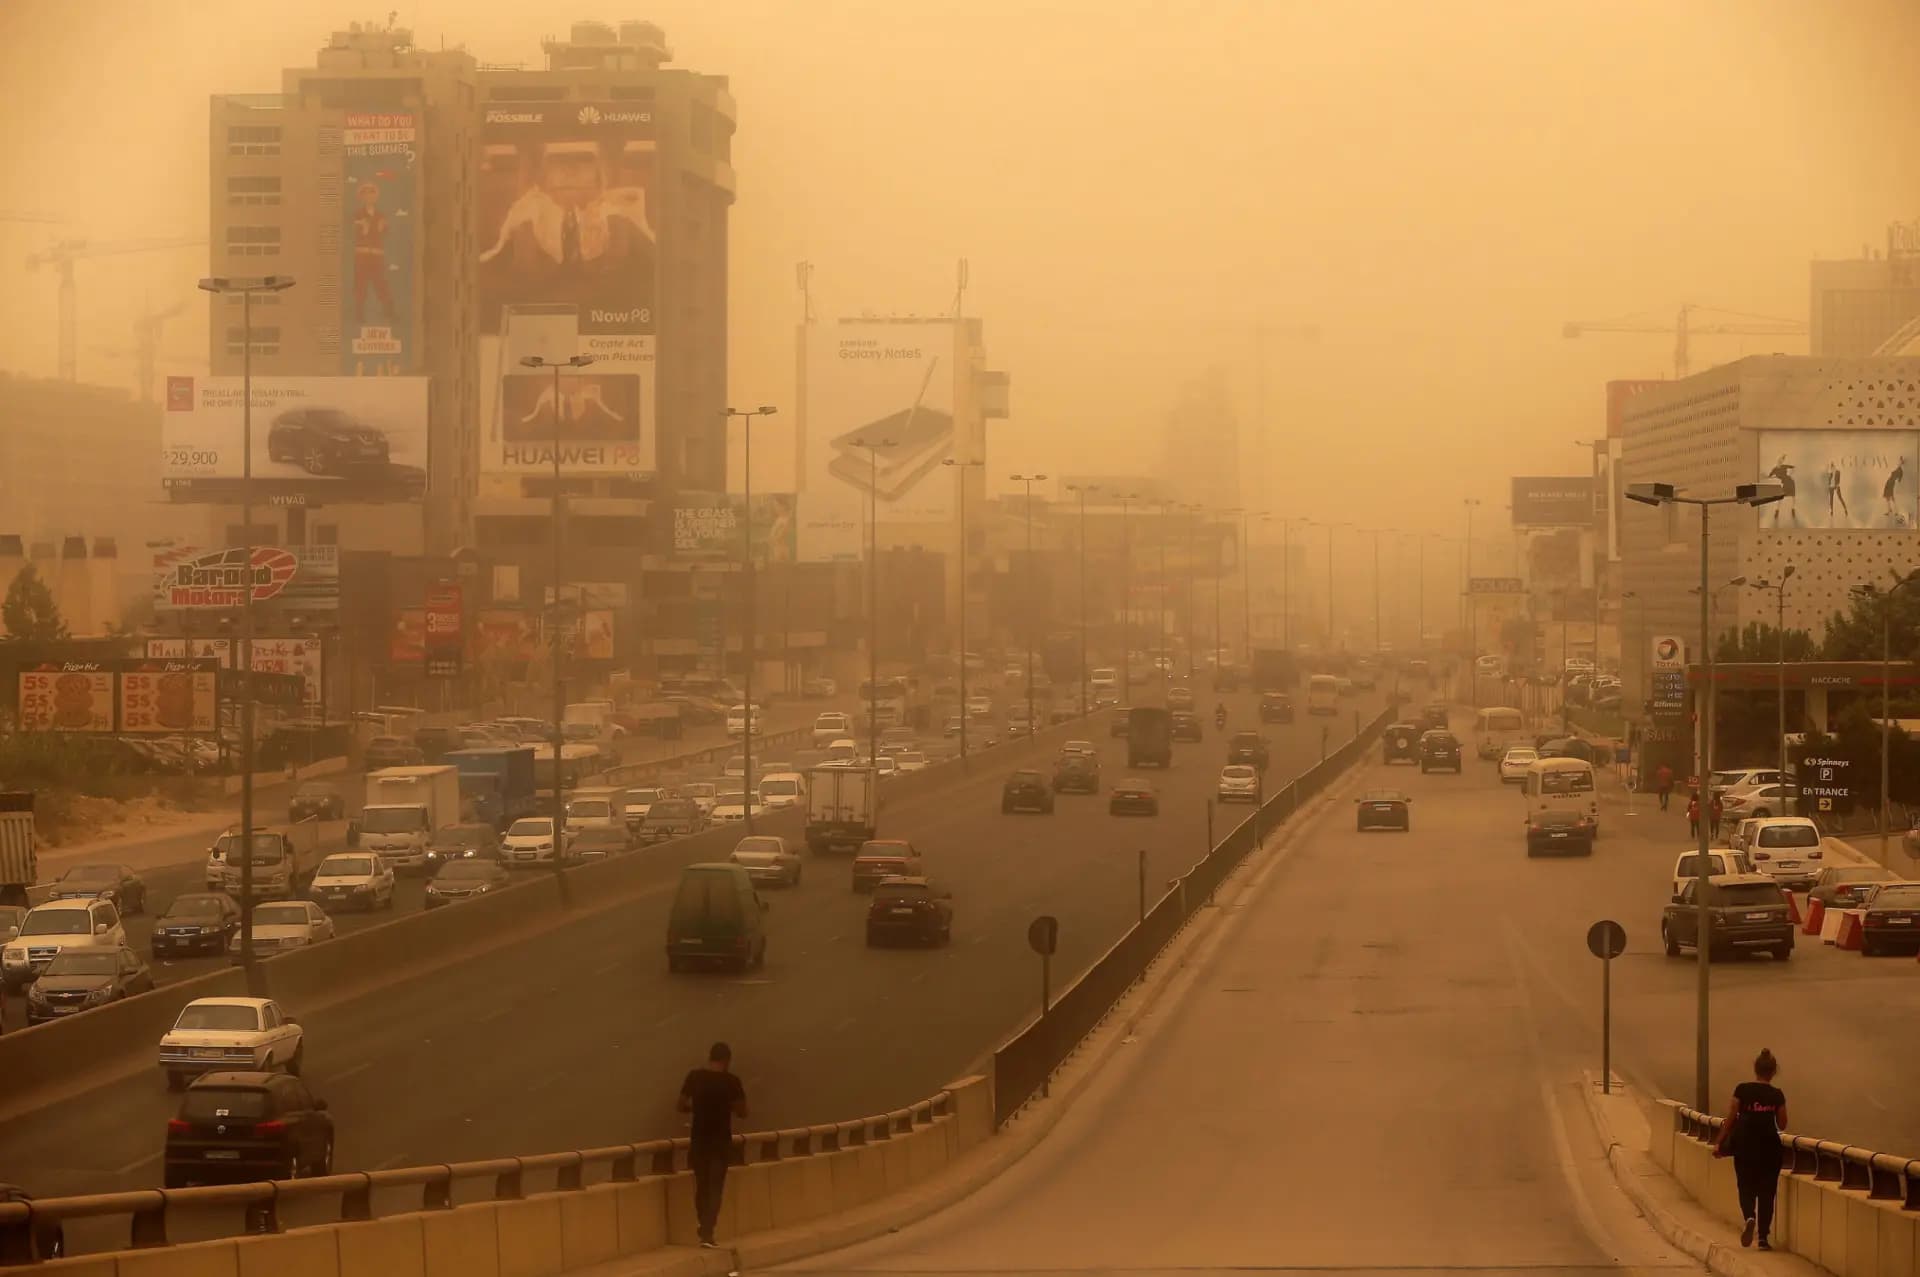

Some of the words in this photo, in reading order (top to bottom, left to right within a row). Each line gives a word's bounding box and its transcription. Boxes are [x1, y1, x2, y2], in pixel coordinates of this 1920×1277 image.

[393, 115, 412, 127] YOU
[486, 112, 543, 123] POSSIBLE
[603, 113, 651, 123] HUAWEI
[592, 309, 628, 323] Now
[631, 308, 650, 323] P8
[589, 338, 624, 349] Create
[627, 339, 644, 348] Art
[612, 351, 655, 362] Pictures
[838, 348, 882, 361] Galaxy
[884, 347, 921, 360] Note5
[502, 447, 605, 465] HUAWEI
[613, 445, 640, 466] P8
[698, 508, 735, 519] GRASS
[427, 612, 437, 632] 3
[1810, 676, 1852, 684] NACCACHE
[1817, 757, 1850, 768] Spinneys
[1822, 769, 1831, 779] P
[1802, 787, 1849, 797] ENTRANCE
